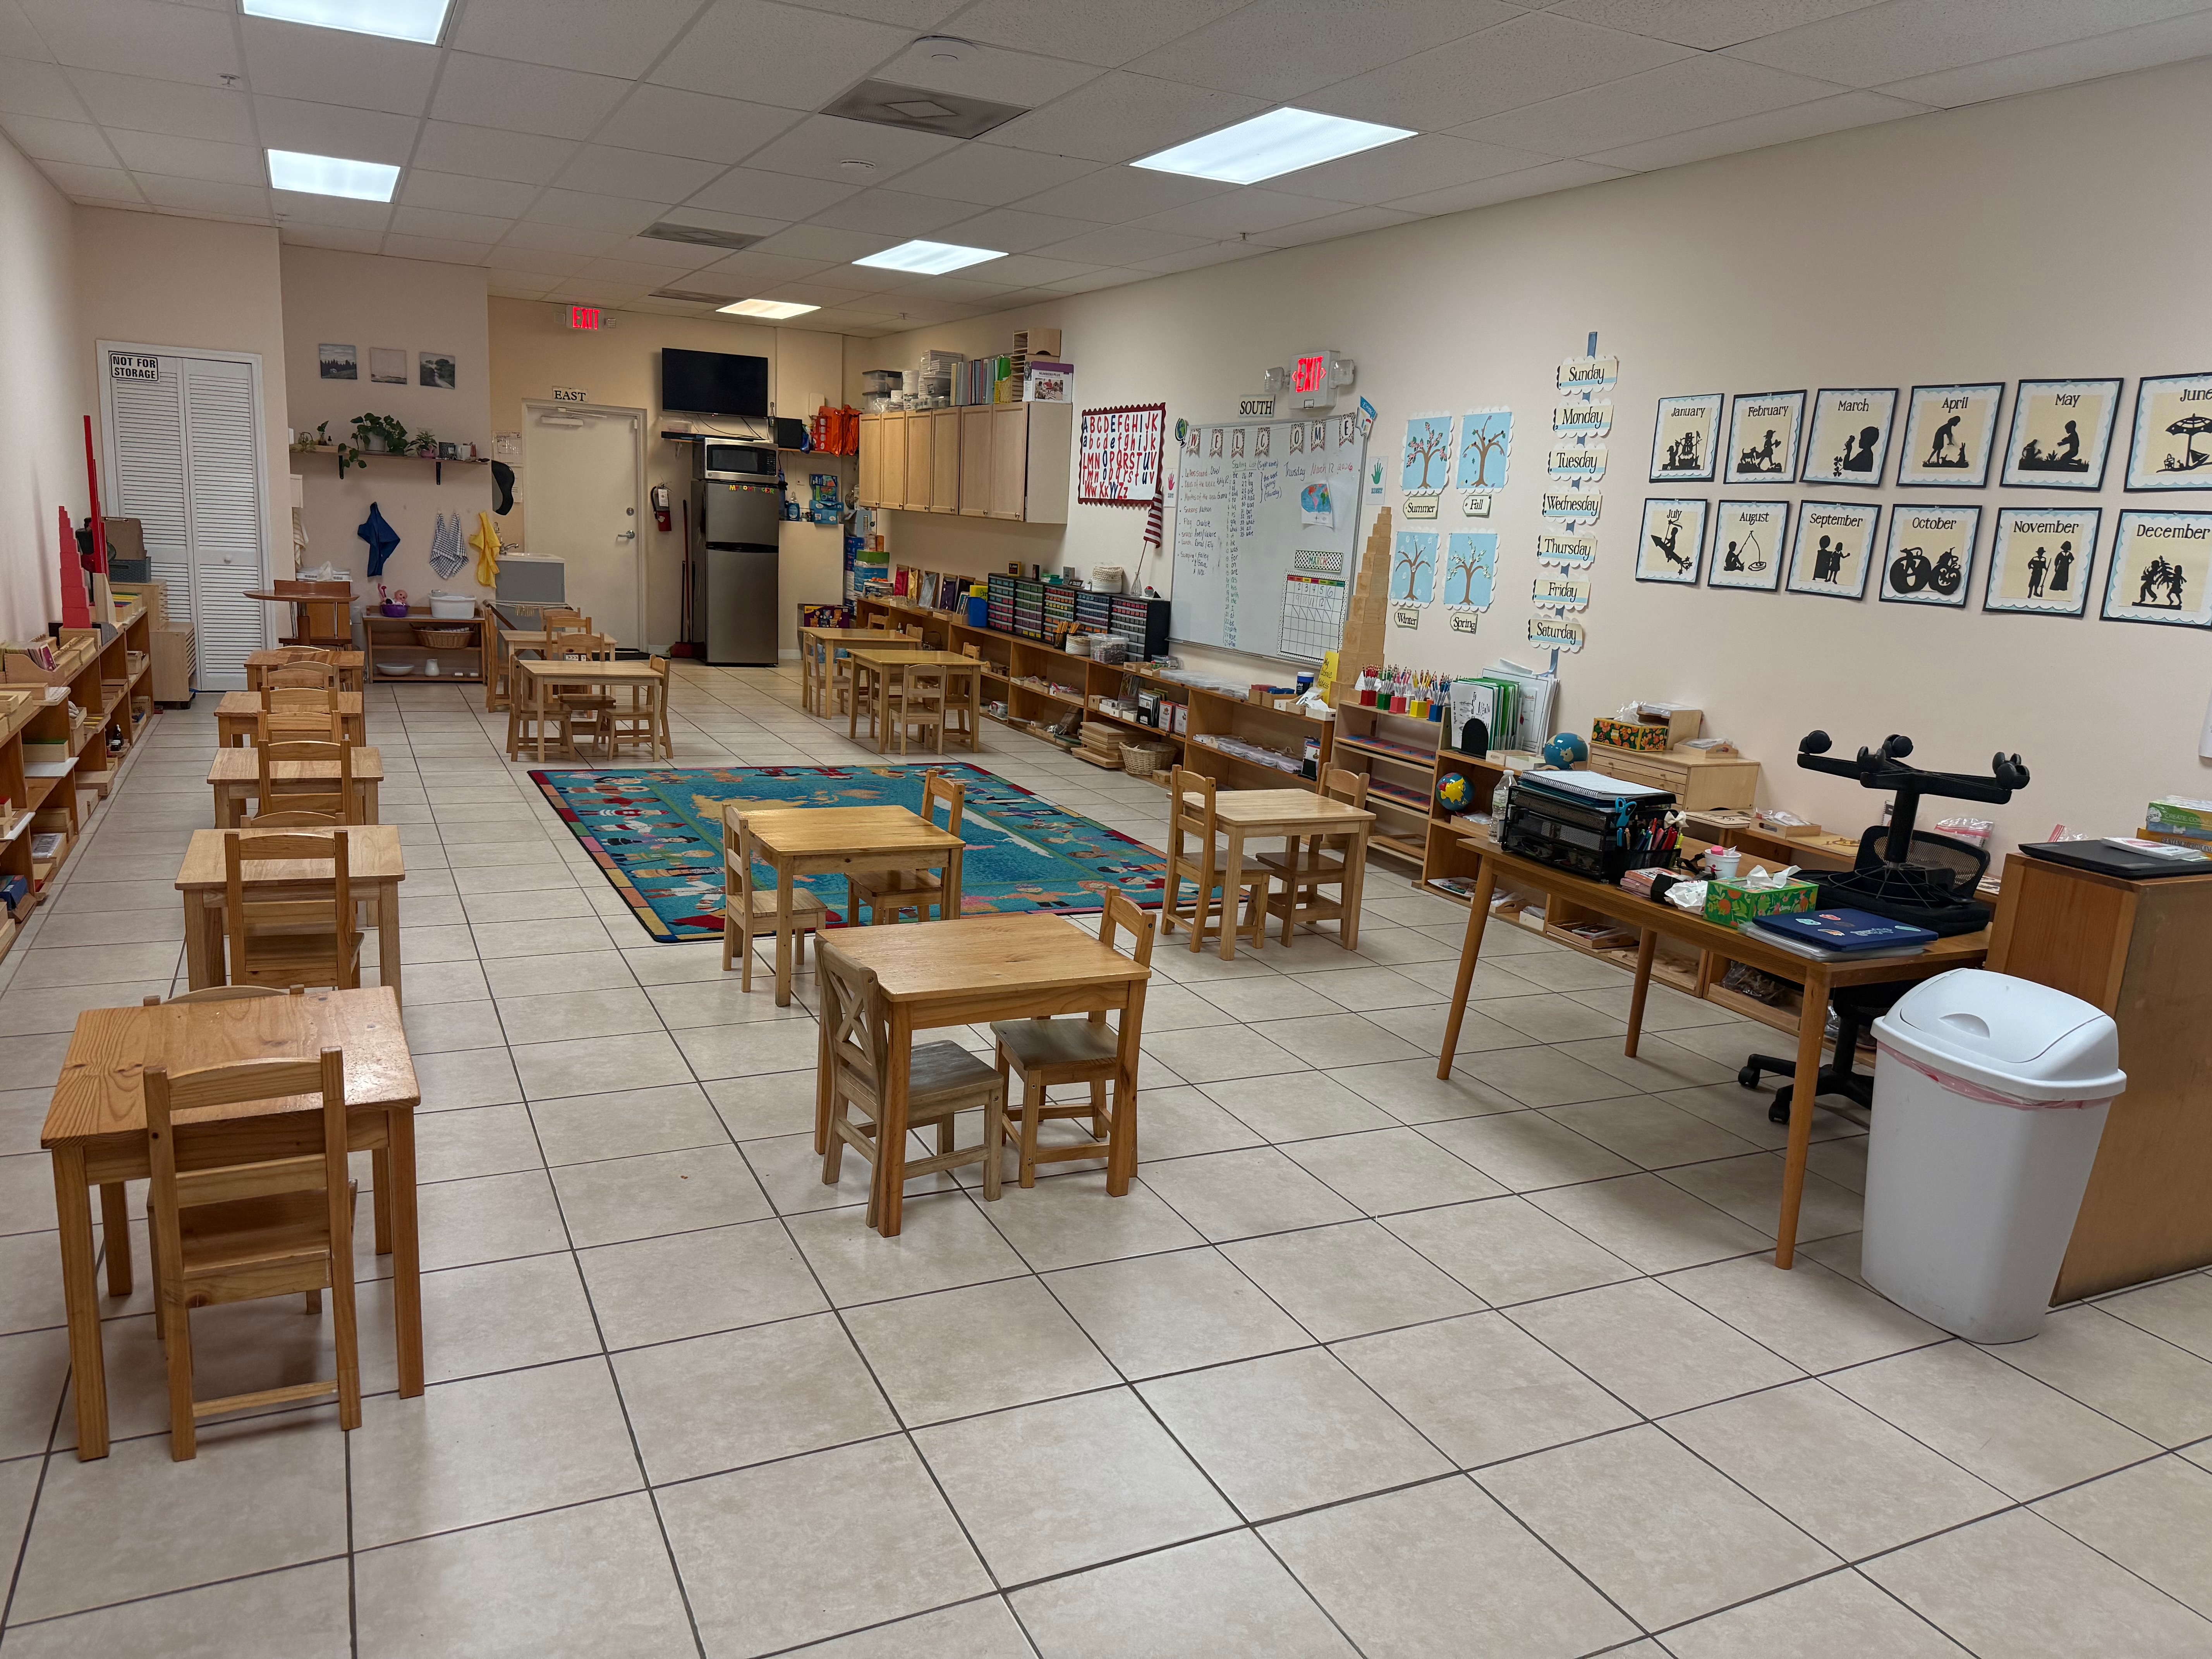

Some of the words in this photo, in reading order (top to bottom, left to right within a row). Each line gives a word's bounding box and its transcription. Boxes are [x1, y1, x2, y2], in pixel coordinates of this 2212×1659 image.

[573, 306, 600, 330] EXIT
[113, 356, 132, 366] NOT
[137, 359, 155, 368] FOR
[115, 368, 155, 379] STORAGE
[1296, 355, 1323, 393] EXIT
[1569, 364, 1604, 384] Sunday
[554, 390, 586, 401] EAST
[2055, 393, 2081, 408] May
[2180, 388, 2212, 402] June
[1240, 400, 1273, 415] SOUTH
[1671, 407, 1705, 417] January
[1748, 405, 1789, 417] February
[1838, 399, 1869, 412] March
[1941, 397, 1969, 413] April
[1562, 406, 1603, 429] Monday
[1556, 451, 1597, 474] Tuesday
[1407, 502, 1435, 513] Summer
[1470, 499, 1483, 510] Fall
[1547, 495, 1599, 516] Wednesday
[1667, 509, 1682, 520] July
[1739, 512, 1769, 525] August
[1810, 513, 1863, 527] September
[1912, 517, 1957, 530] October
[2013, 520, 2079, 534] November
[2136, 524, 2210, 540] December
[1545, 539, 1591, 561] Thursday
[1309, 556, 1327, 567] MARCH
[1548, 582, 1577, 603] Friday
[1398, 612, 1417, 625] Winter
[1453, 617, 1475, 632] Spring
[1537, 622, 1576, 645] Saturday
[1324, 658, 1329, 670] My
